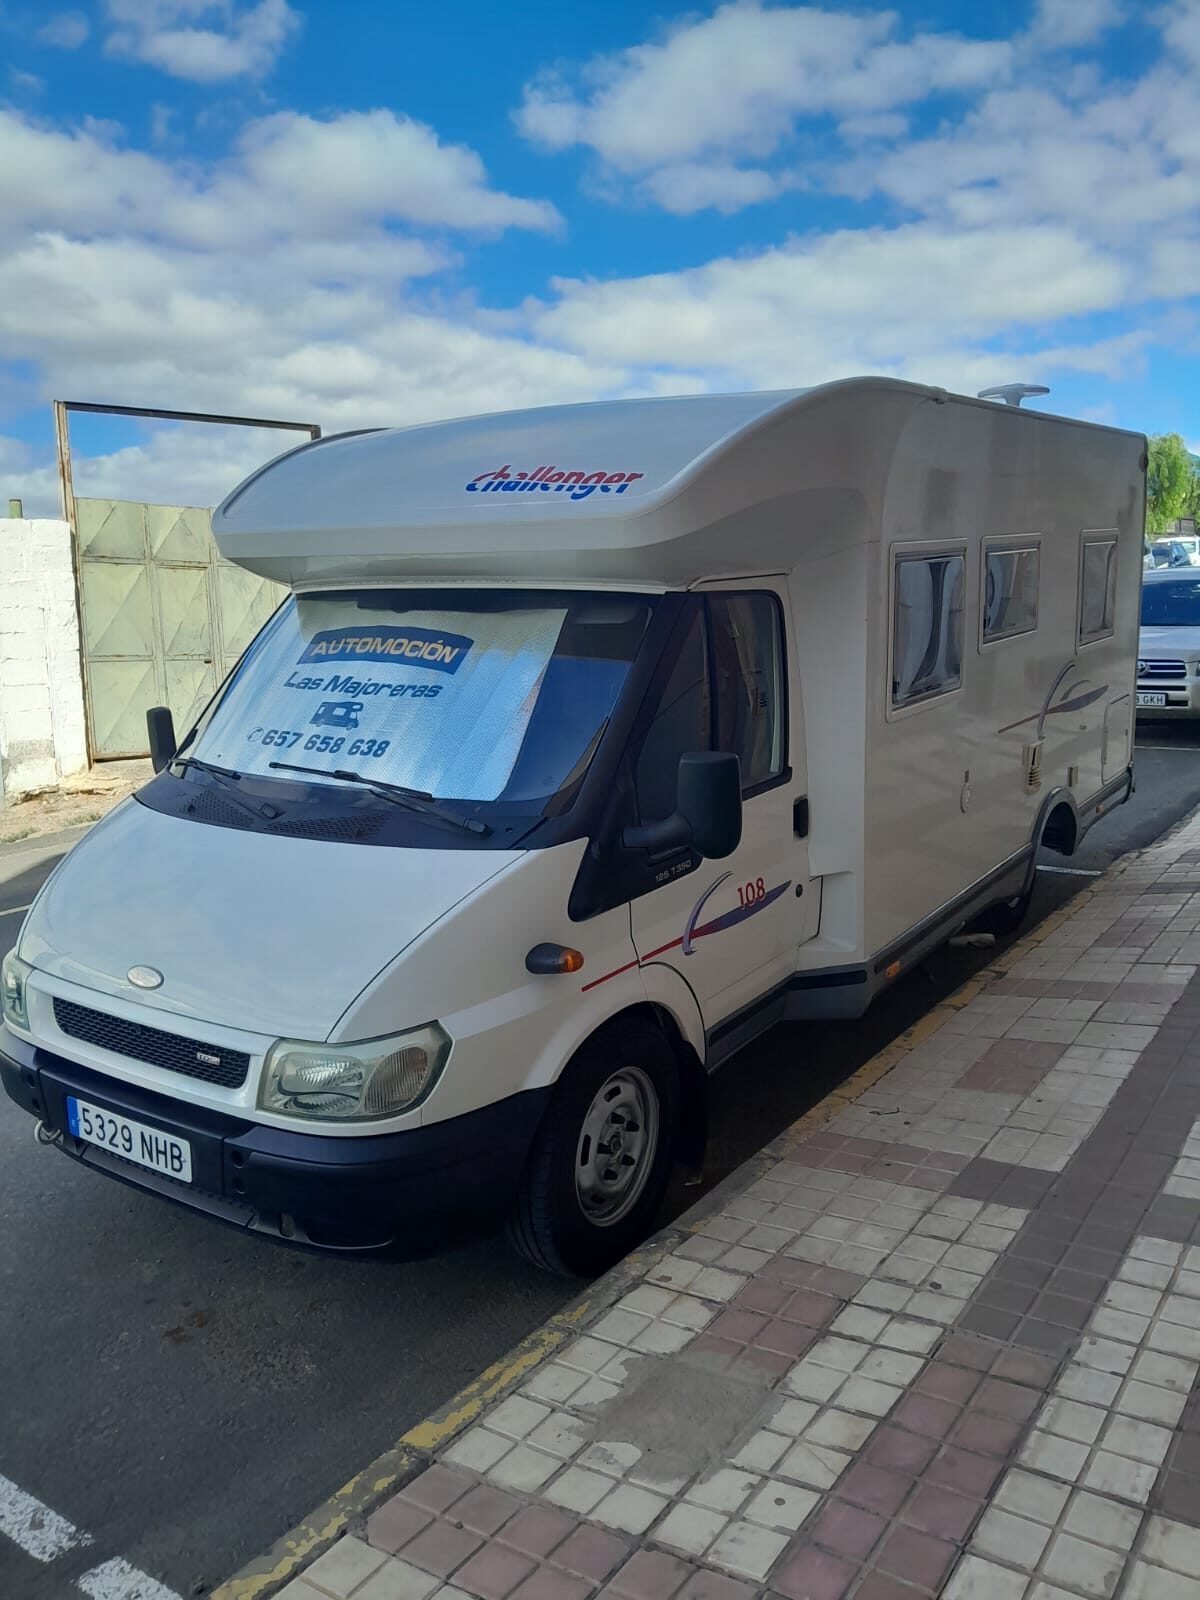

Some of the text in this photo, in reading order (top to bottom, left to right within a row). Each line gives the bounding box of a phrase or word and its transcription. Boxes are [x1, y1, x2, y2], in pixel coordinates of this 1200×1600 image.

[465, 464, 644, 501] challenger
[310, 637, 460, 664] AUTOMOCIÓN
[283, 672, 443, 699] Las Majoreras
[261, 729, 391, 758] 657 658 638
[737, 877, 766, 908] 108
[81, 1106, 184, 1174] 5329 NHB
